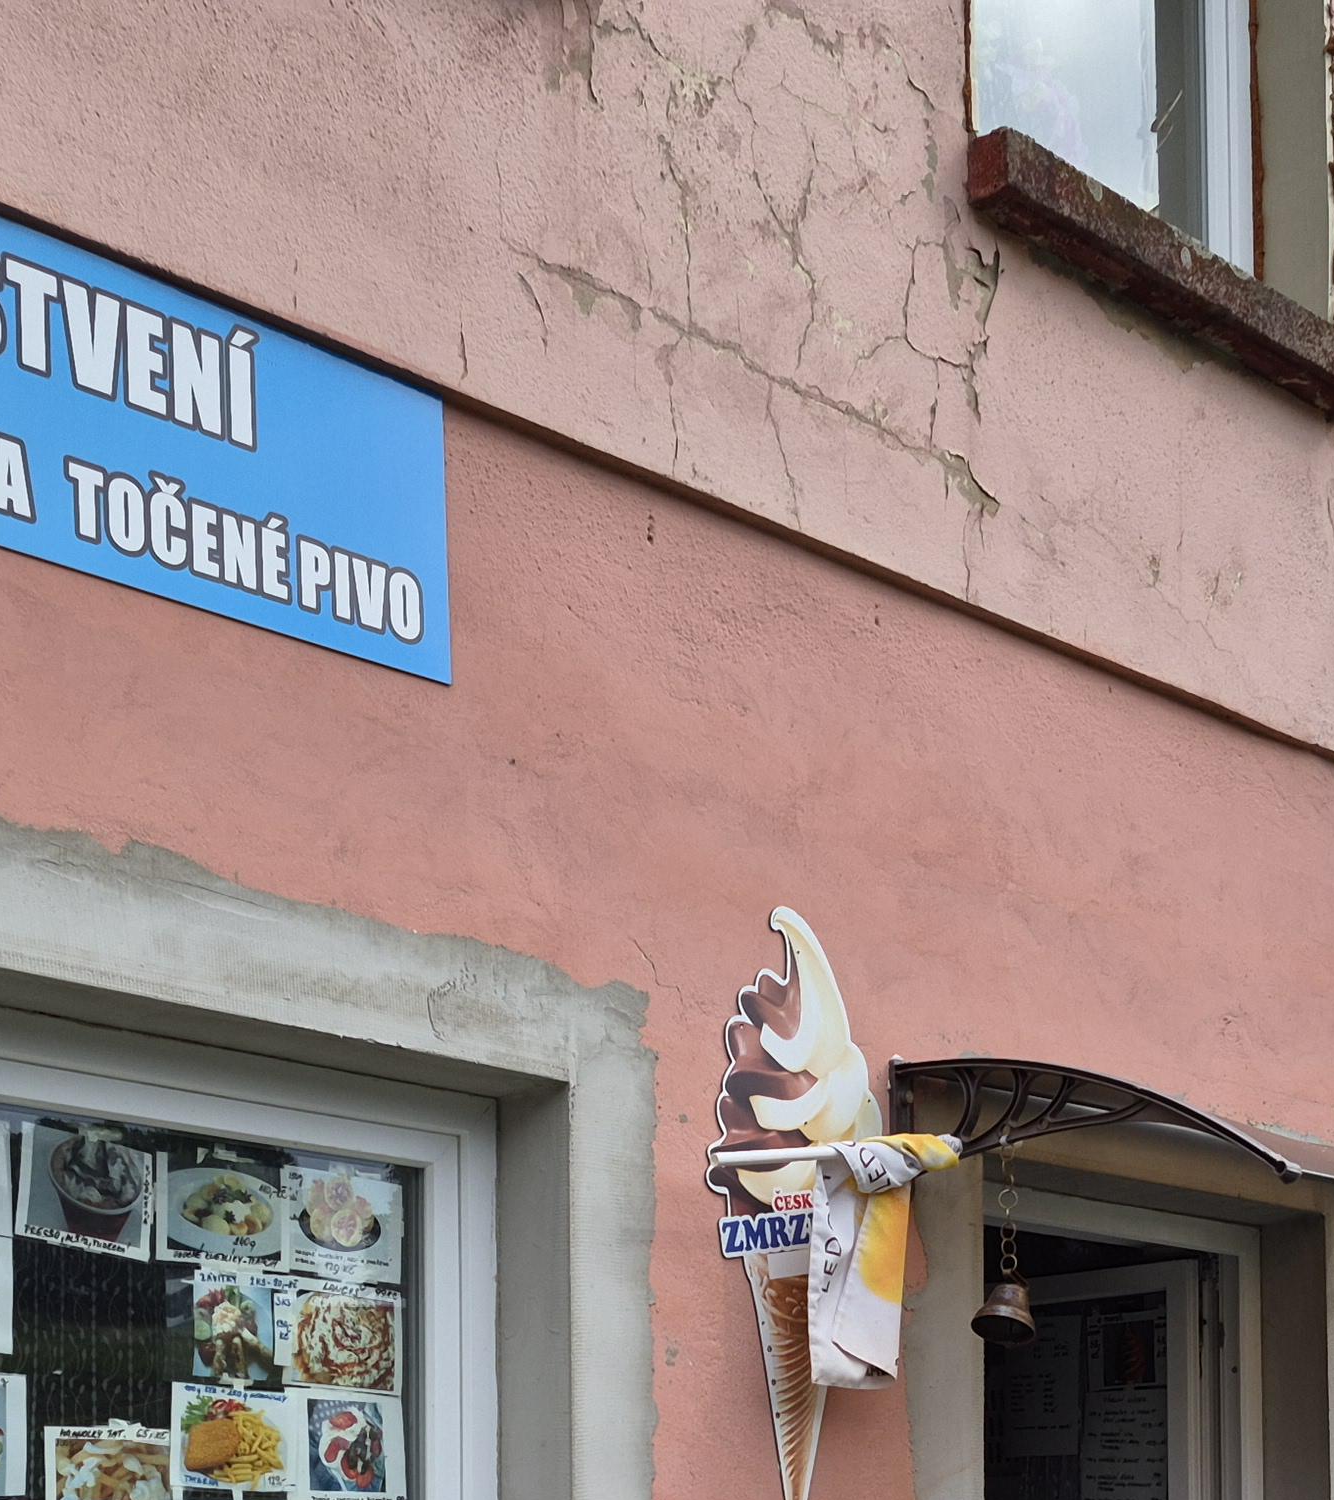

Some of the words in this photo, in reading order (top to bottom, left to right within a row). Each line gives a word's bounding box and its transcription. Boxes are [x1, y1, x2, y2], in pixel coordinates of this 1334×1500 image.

[65, 459, 295, 604] TOČENÉ
[298, 538, 427, 646] PIVO
[853, 1144, 892, 1192] LED
[774, 1189, 813, 1211] ČESK
[722, 1213, 813, 1252] ZMRZ
[820, 1226, 842, 1293] LED
